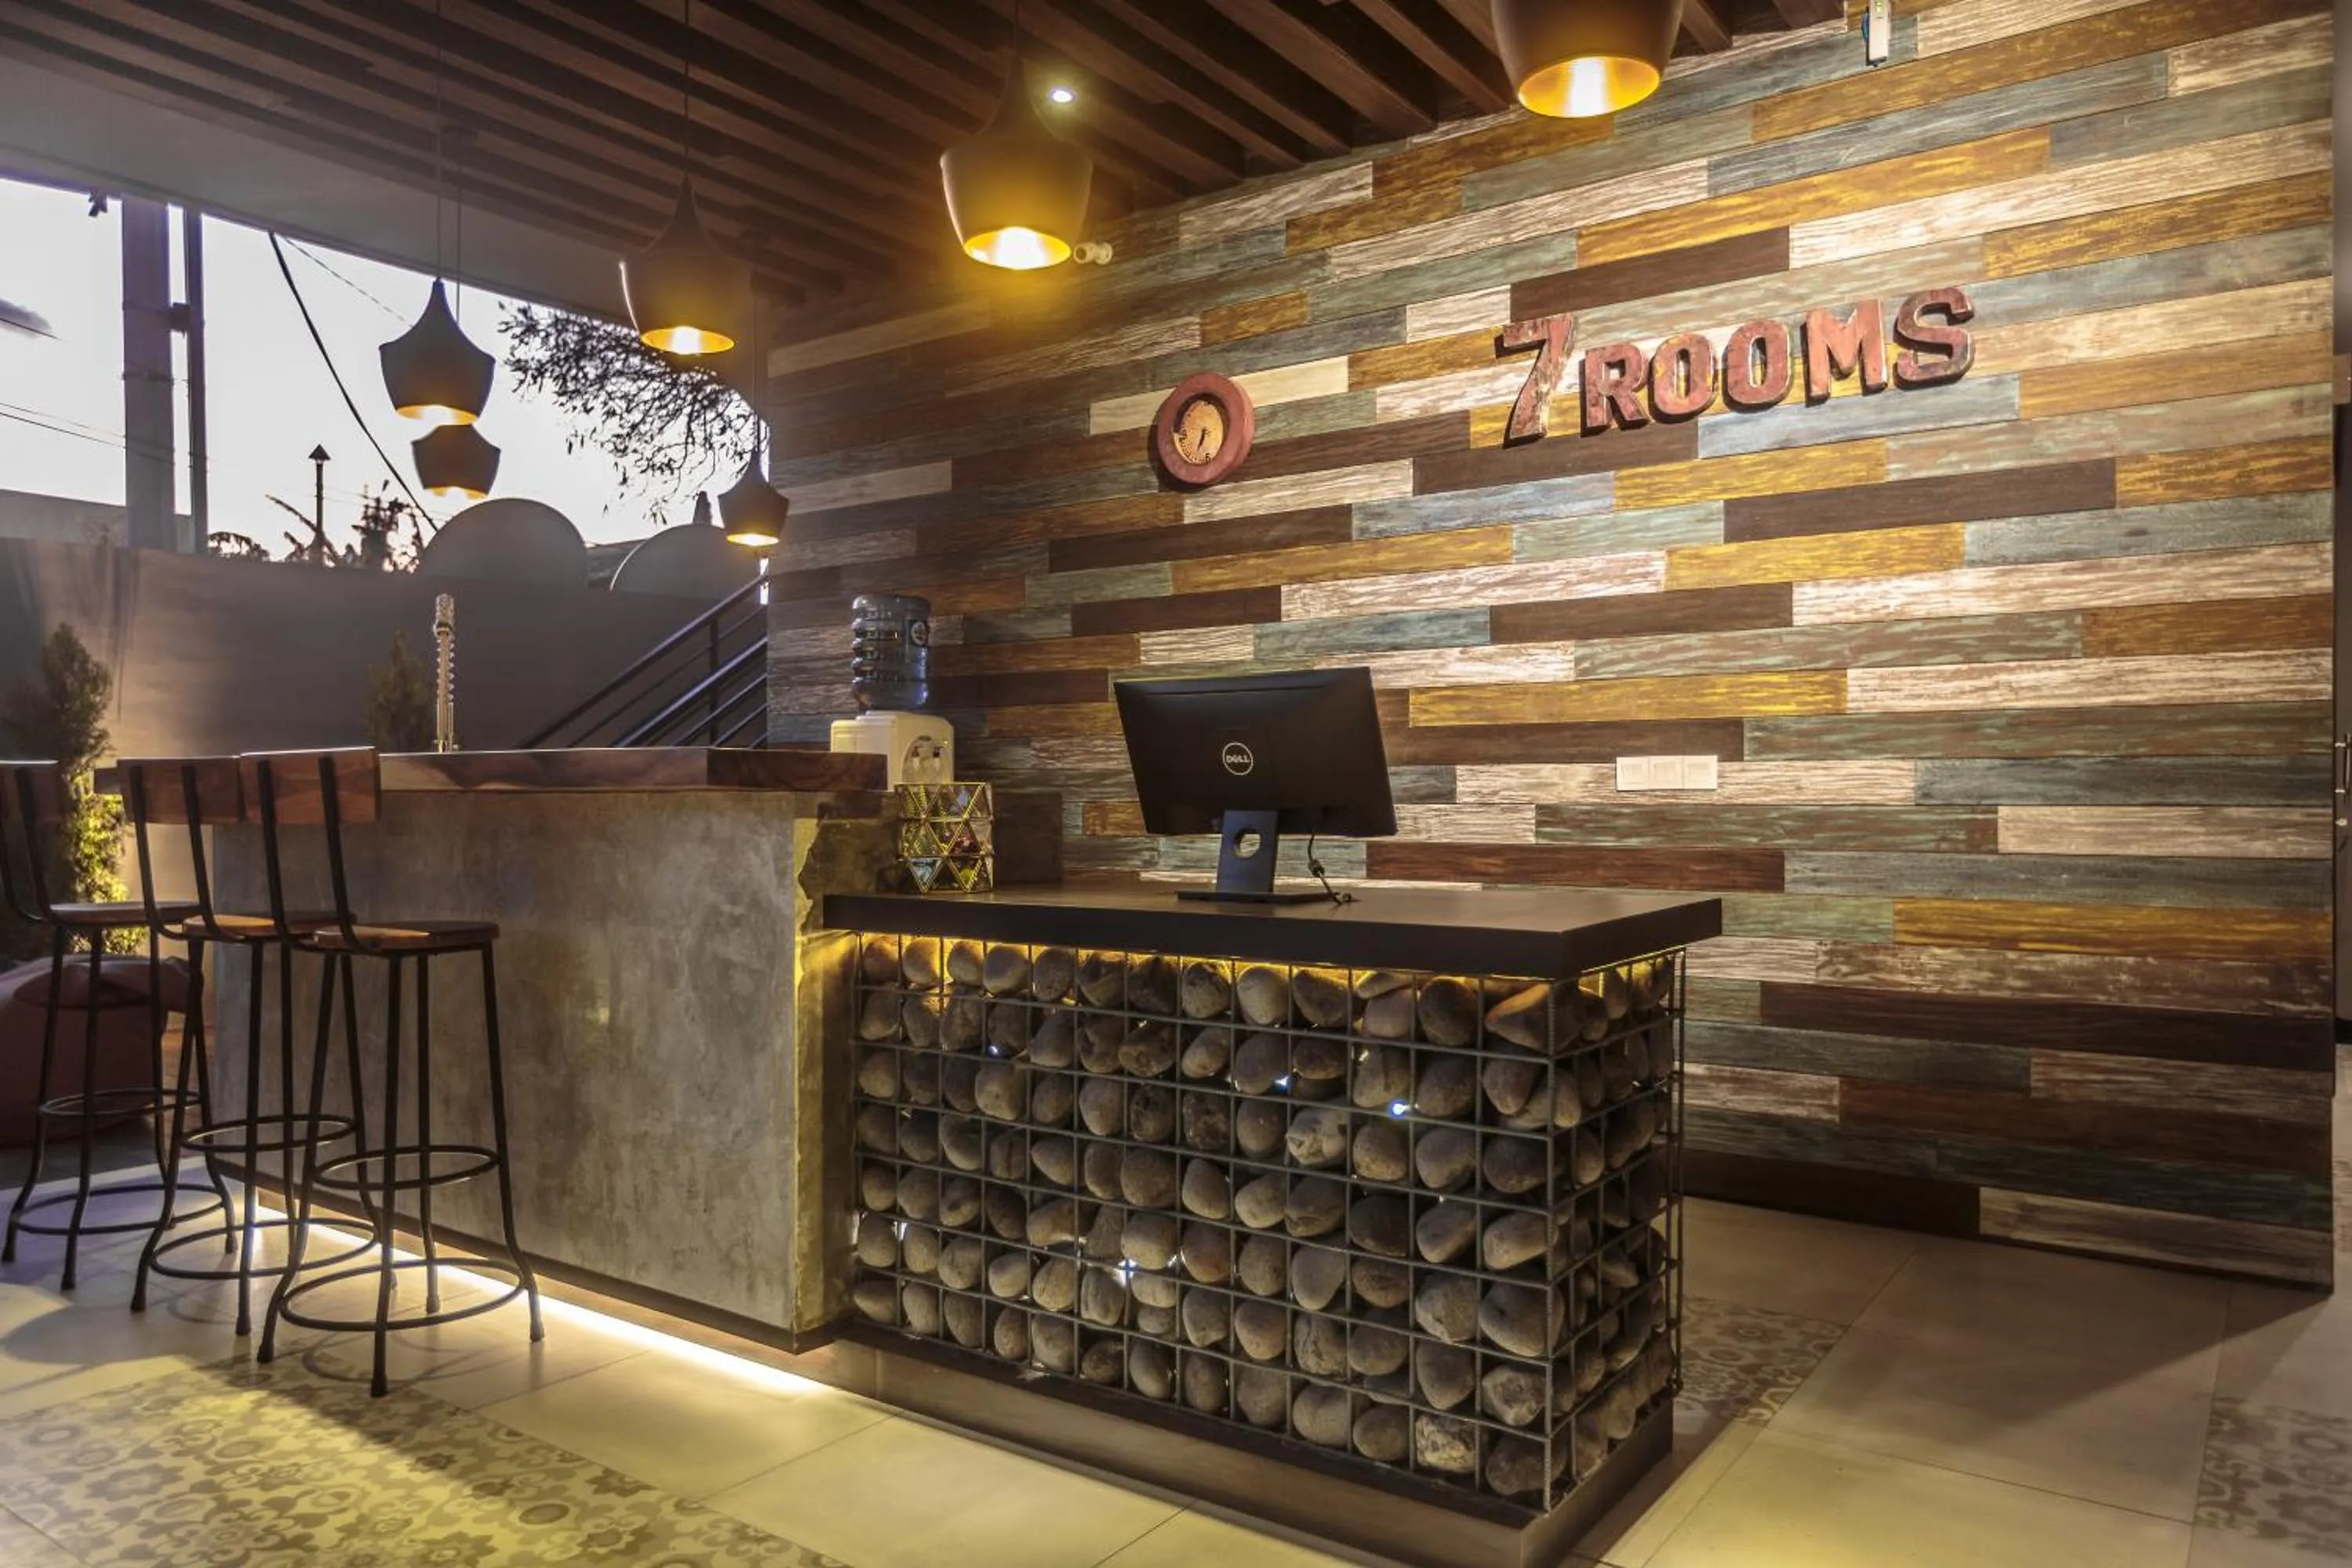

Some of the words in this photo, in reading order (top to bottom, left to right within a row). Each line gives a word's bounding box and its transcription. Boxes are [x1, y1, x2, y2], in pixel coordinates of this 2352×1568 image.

[1496, 314, 1576, 447] 7
[1581, 286, 1975, 435] ROOMS
[1225, 754, 1250, 763] DELL
